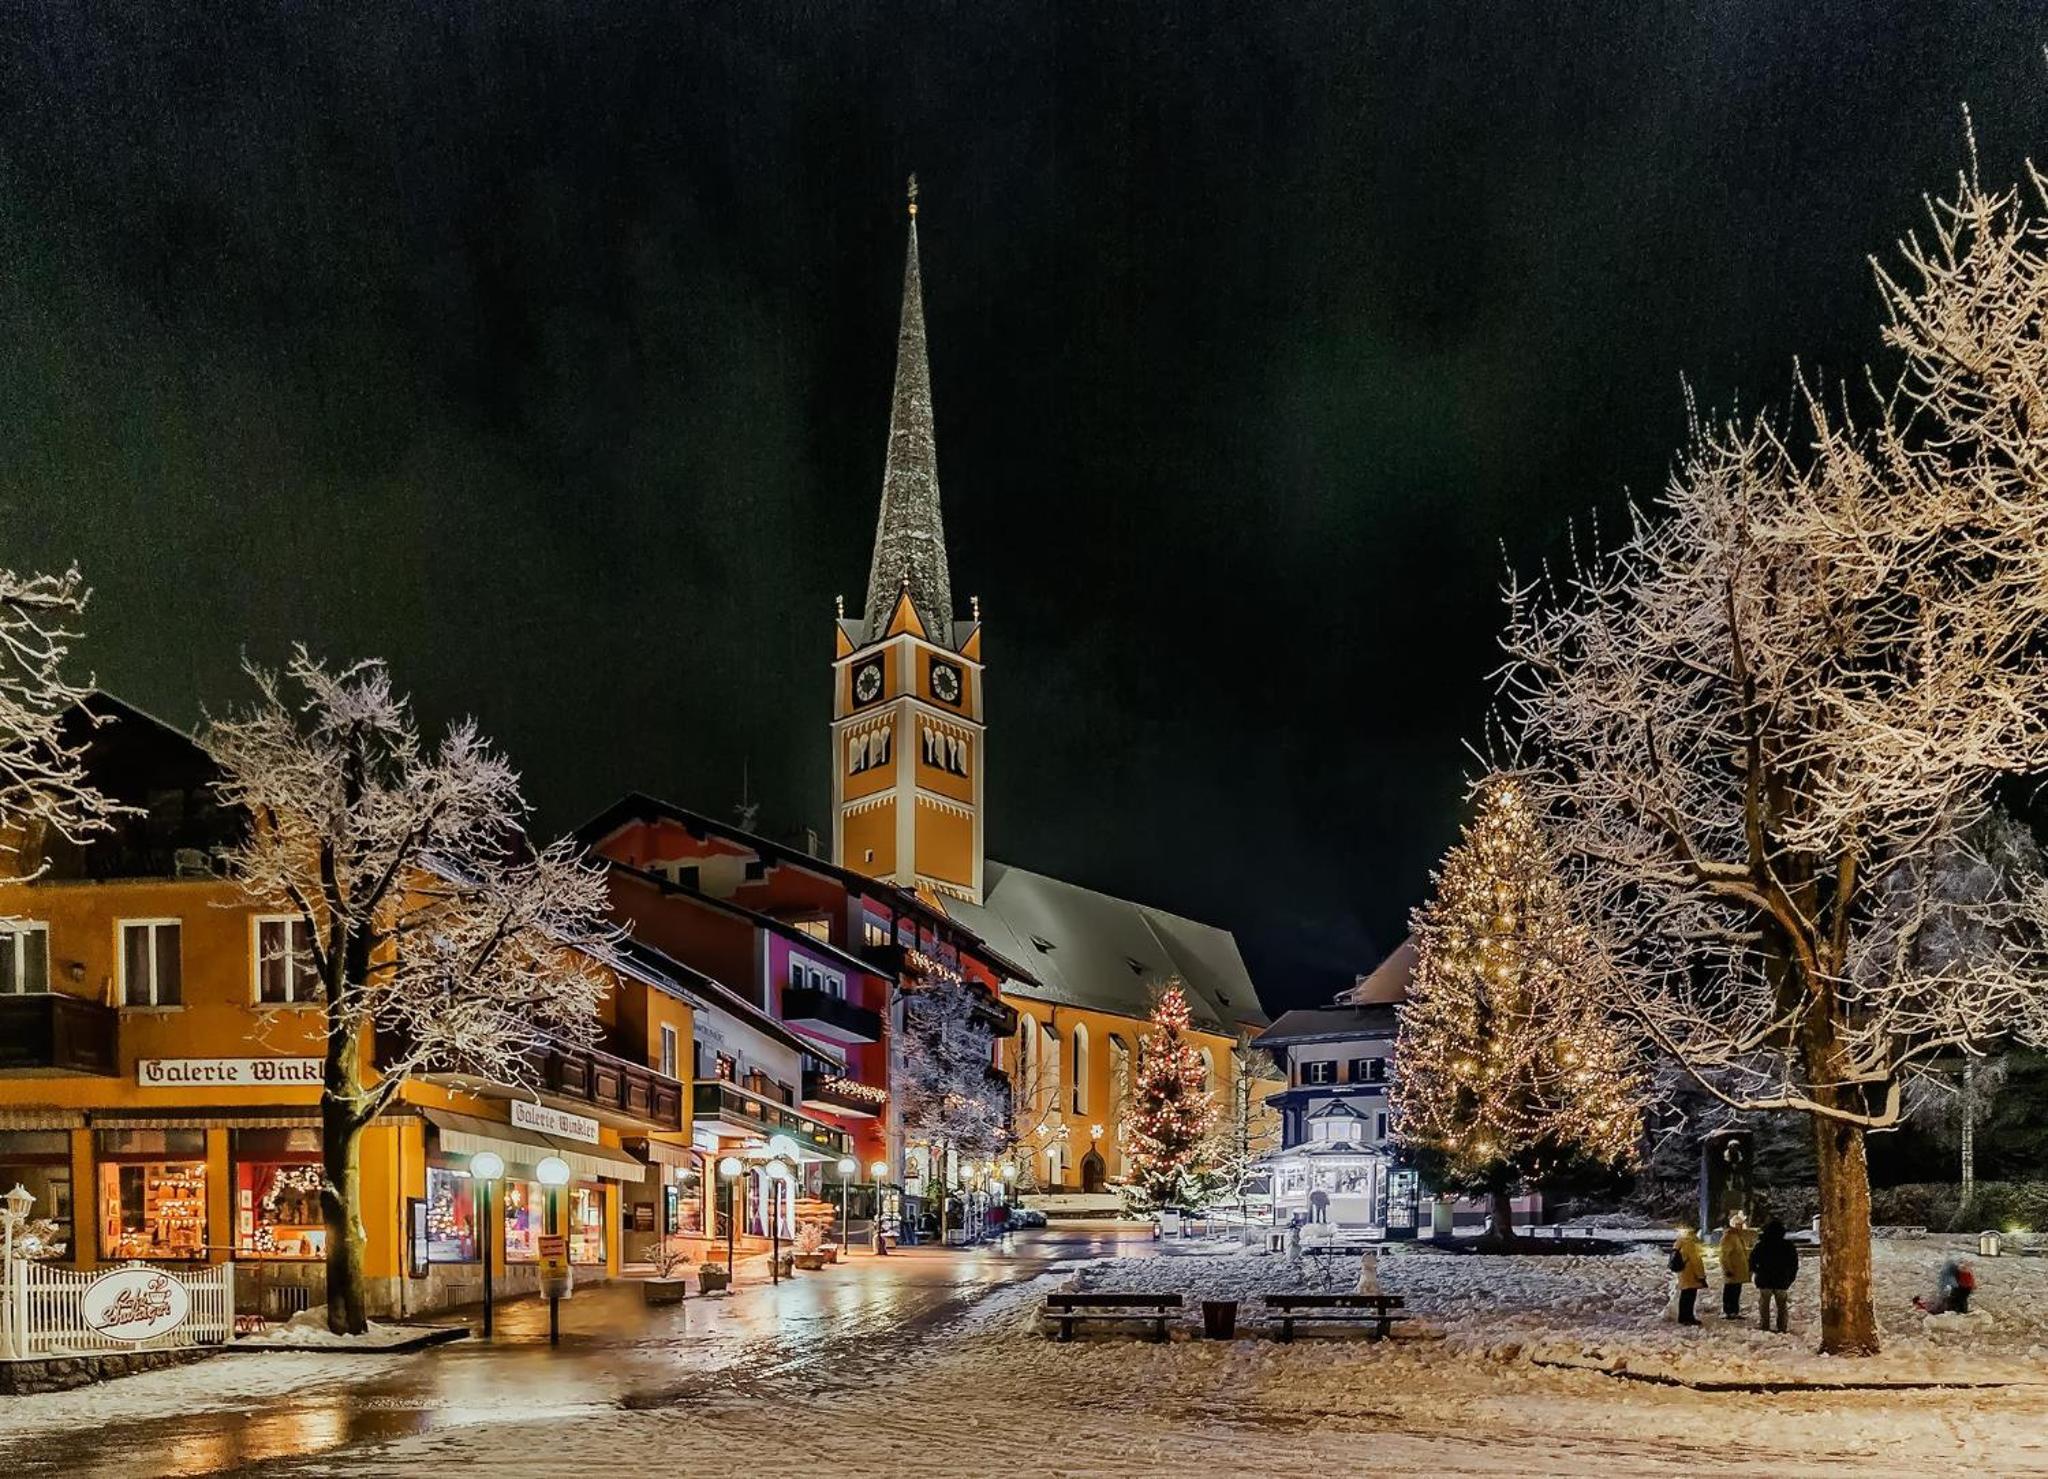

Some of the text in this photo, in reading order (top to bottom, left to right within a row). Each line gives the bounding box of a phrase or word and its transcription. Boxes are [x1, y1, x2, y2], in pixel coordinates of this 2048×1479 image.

[146, 1060, 326, 1082] Galerie Winkl
[516, 1104, 596, 1138] Galerie Winkler
